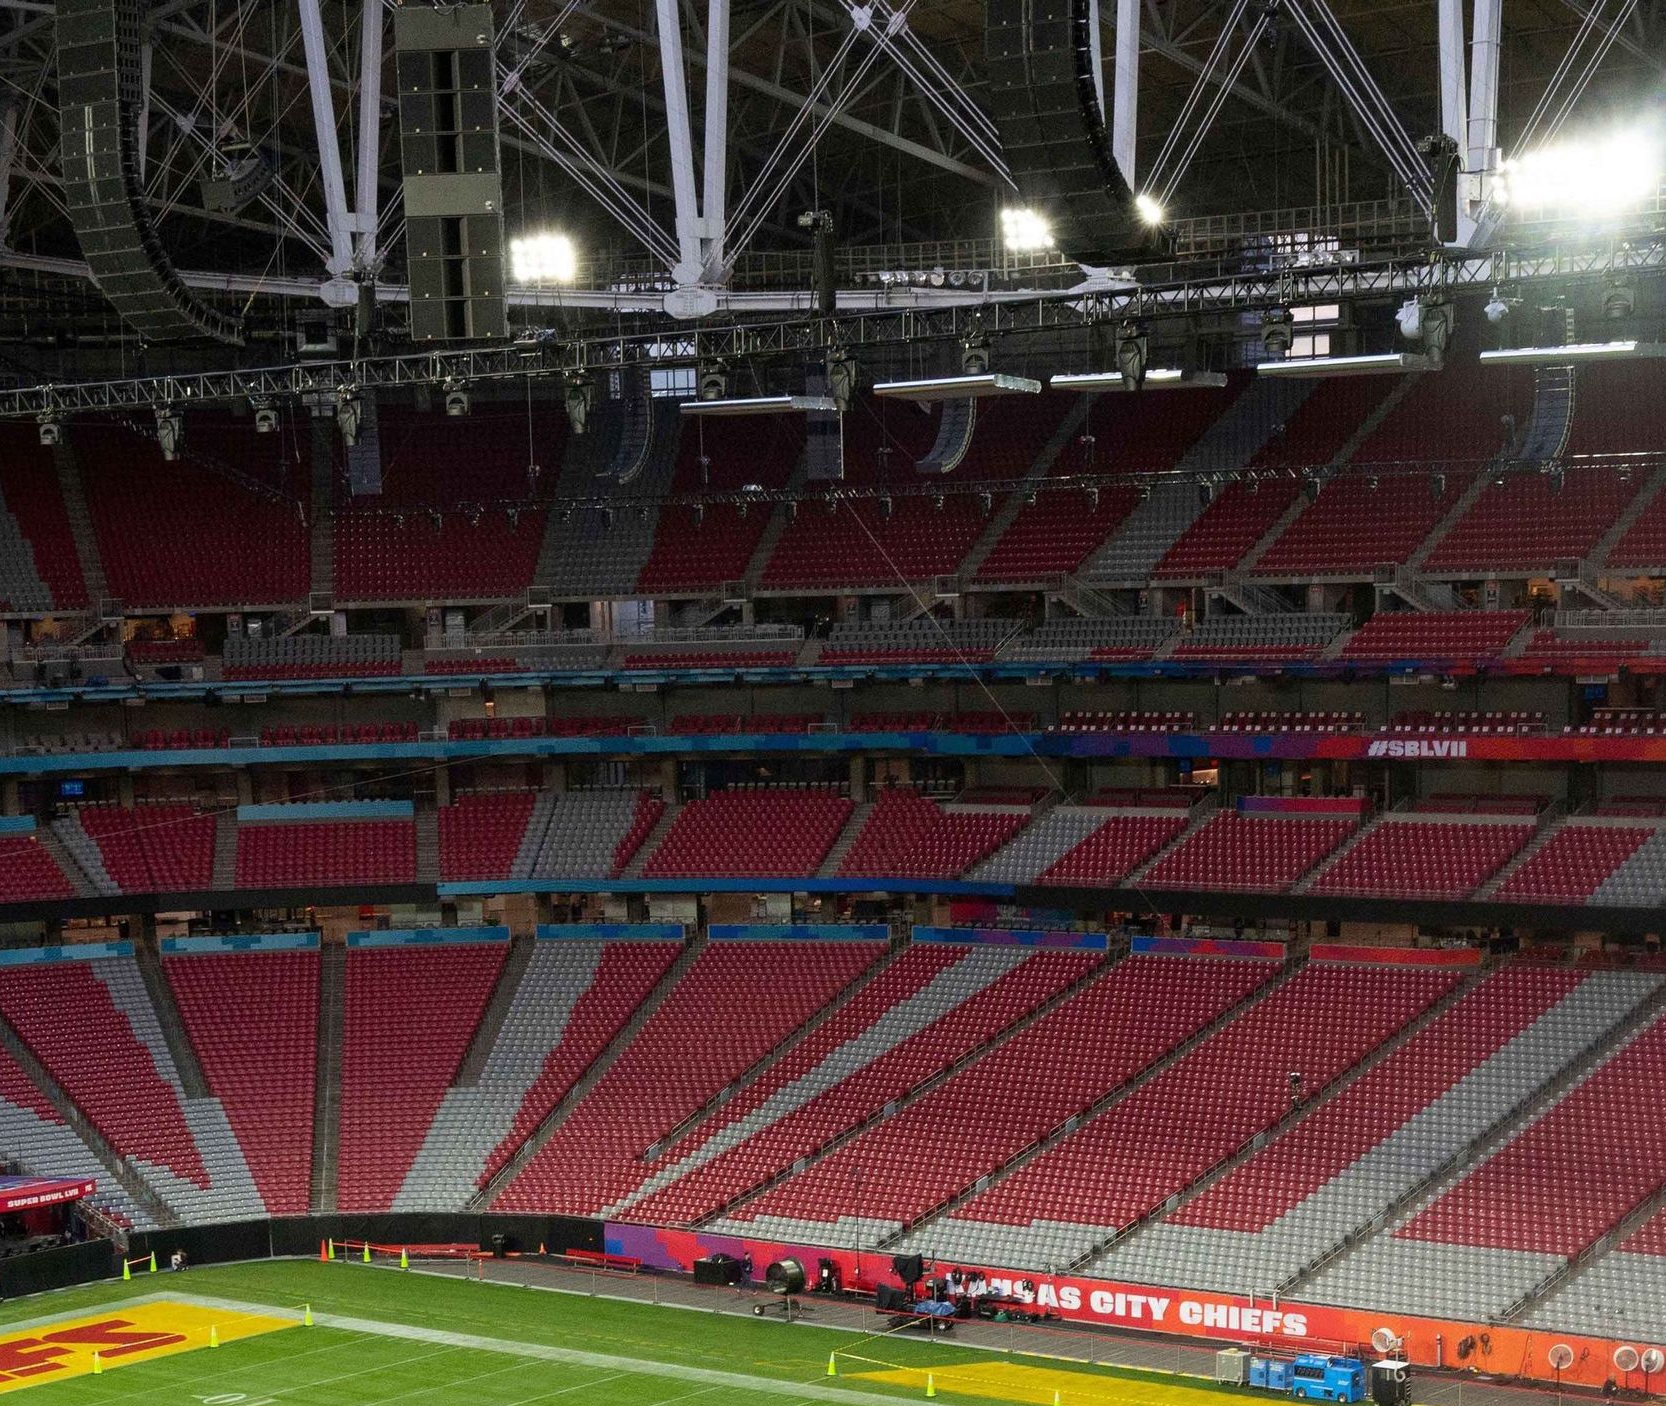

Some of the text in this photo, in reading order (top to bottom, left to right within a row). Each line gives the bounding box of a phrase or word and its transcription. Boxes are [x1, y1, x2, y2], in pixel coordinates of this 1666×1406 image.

[1367, 741, 1467, 758] #SBLVII
[8, 1196, 39, 1208] SUPER
[40, 1192, 64, 1203] BOWL
[1090, 1290, 1170, 1321] CITY
[1179, 1301, 1307, 1337] CHIEFS
